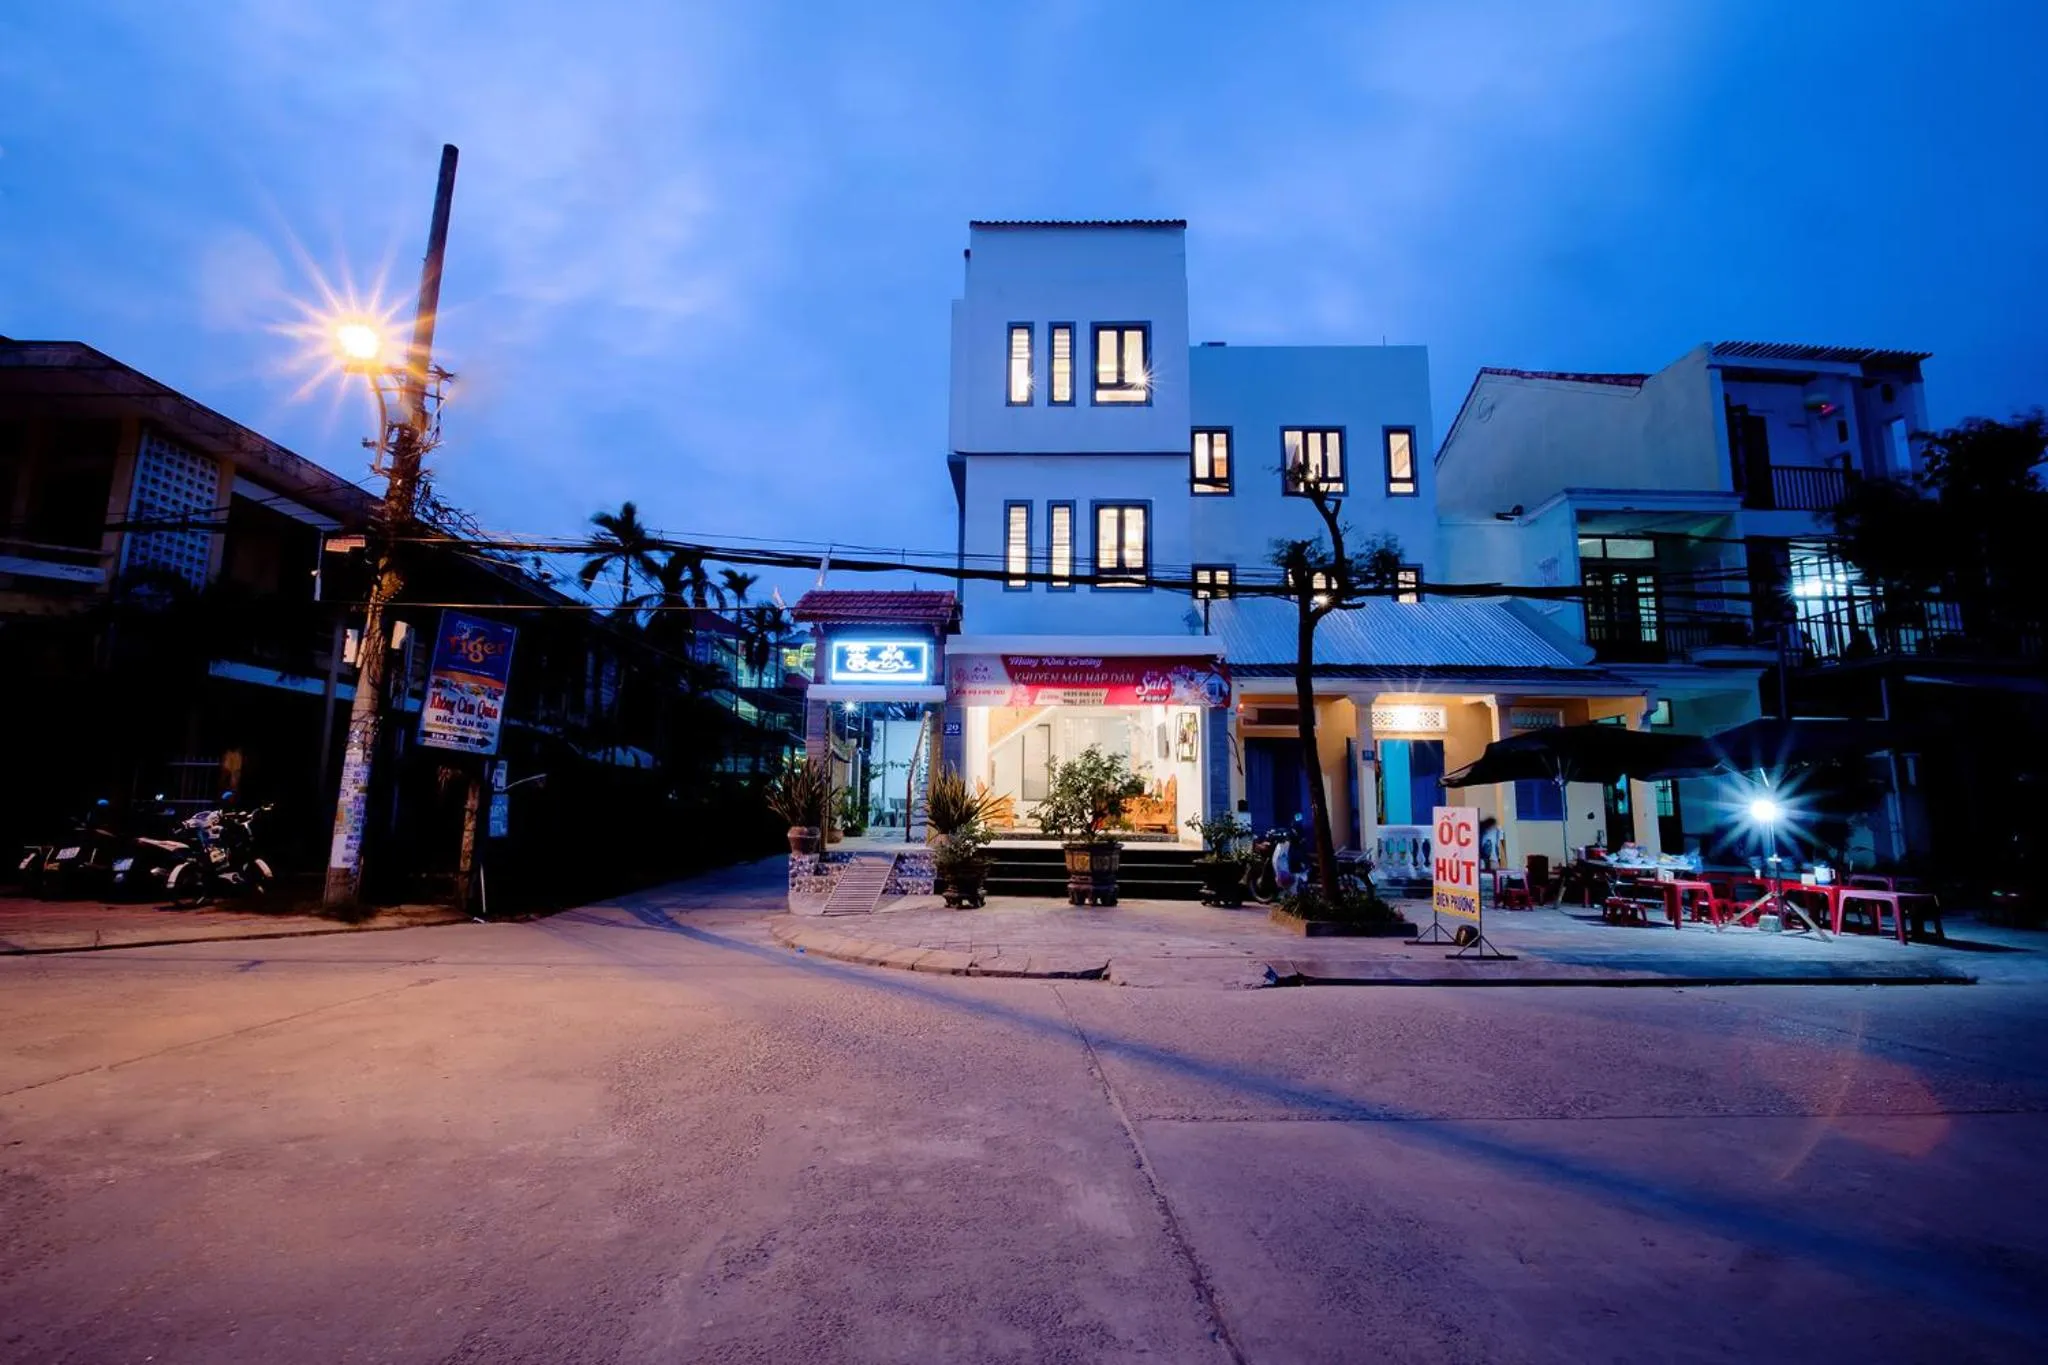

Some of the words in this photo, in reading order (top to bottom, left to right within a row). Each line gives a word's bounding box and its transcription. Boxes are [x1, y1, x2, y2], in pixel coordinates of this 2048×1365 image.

[1135, 675, 1169, 695] Sale
[1438, 811, 1472, 848] ỐC
[1436, 852, 1476, 886] HÚT
